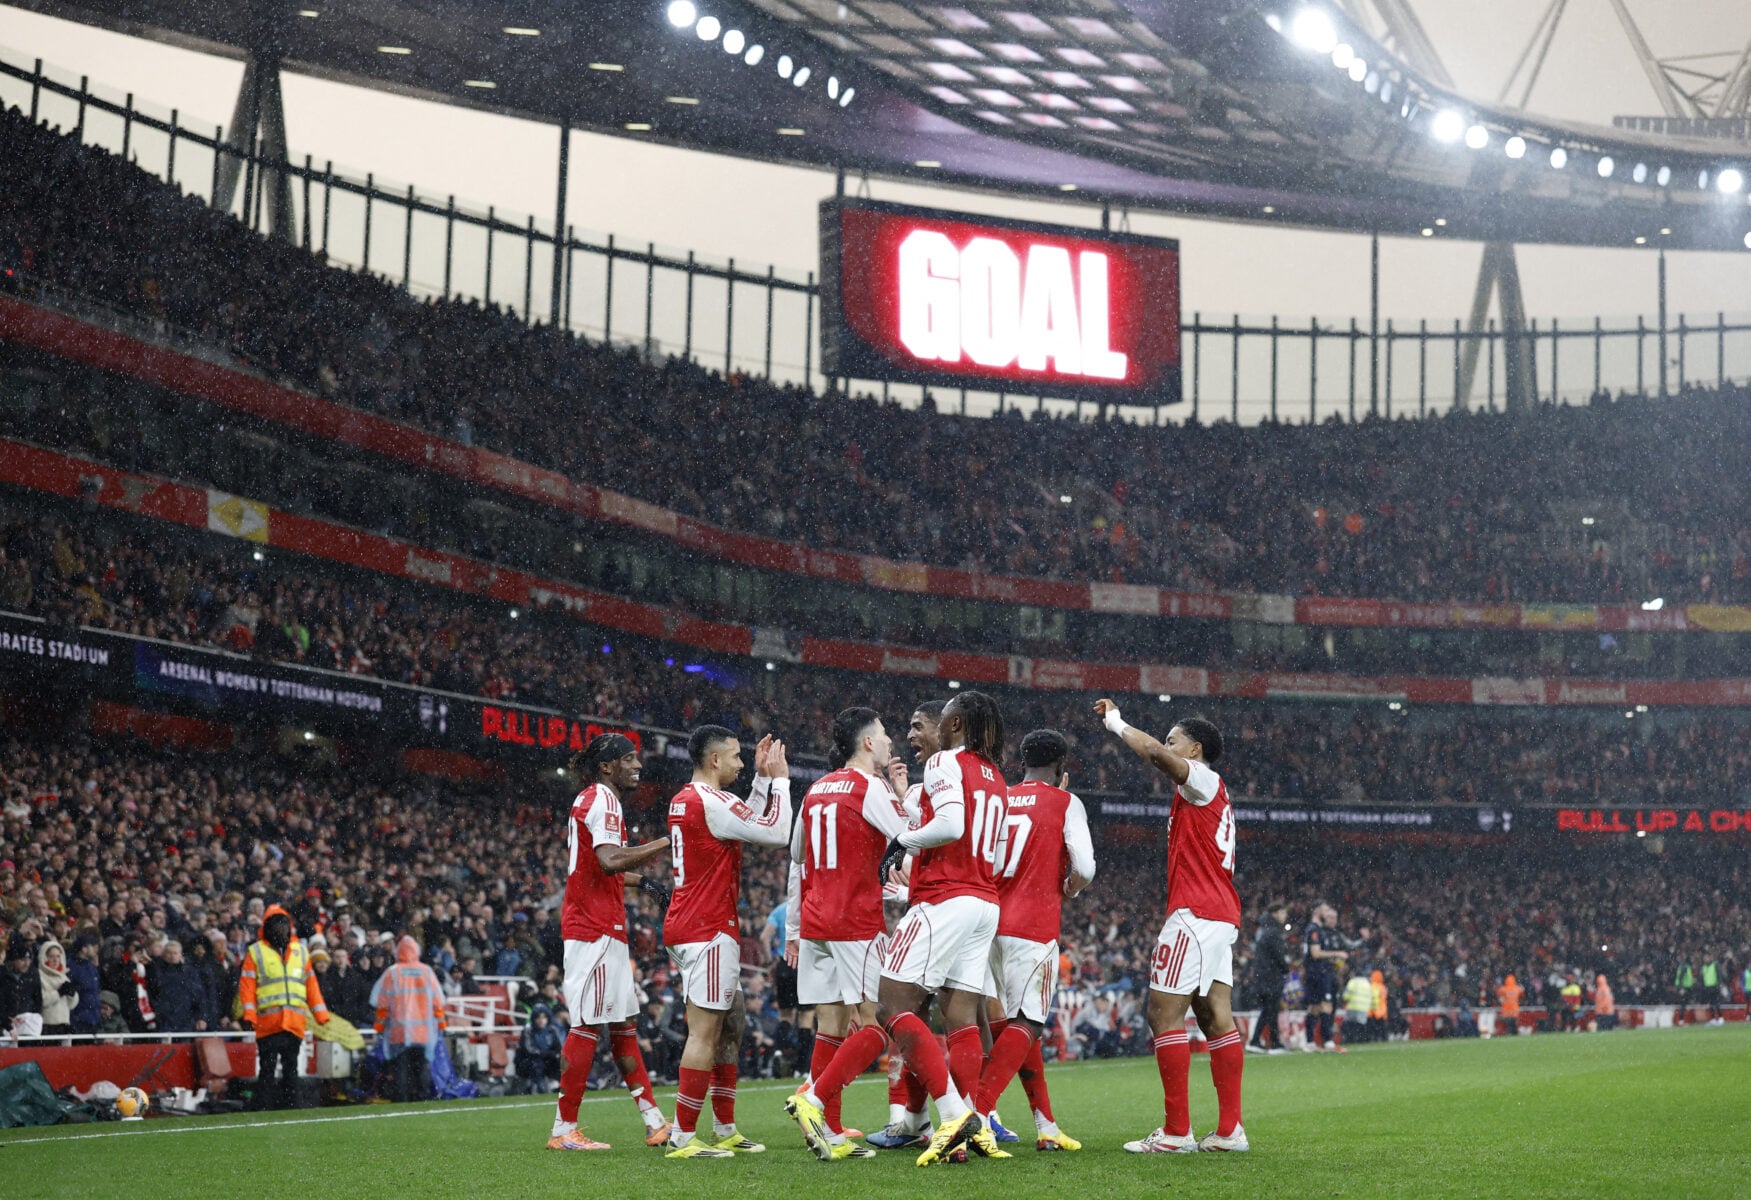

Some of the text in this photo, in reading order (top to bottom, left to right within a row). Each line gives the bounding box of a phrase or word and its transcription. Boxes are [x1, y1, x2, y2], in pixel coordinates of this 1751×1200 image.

[899, 229, 1128, 380] GOAL
[0, 632, 109, 665] RATES STADIUM
[159, 660, 383, 713] ARSENAL WOMEN V TOTTENHAM HOTSPUR
[482, 705, 535, 746] PULL
[537, 715, 567, 749] UP
[568, 722, 583, 751] A
[930, 778, 945, 790] VISIT
[980, 764, 995, 782] EZE
[808, 802, 839, 870] 11
[971, 789, 1005, 865] 10
[1002, 813, 1033, 878] 7
[1214, 804, 1236, 876] 4
[1557, 809, 1631, 832] PULL
[1635, 809, 1679, 833] UP
[1684, 810, 1705, 832] A
[671, 824, 685, 888] 9
